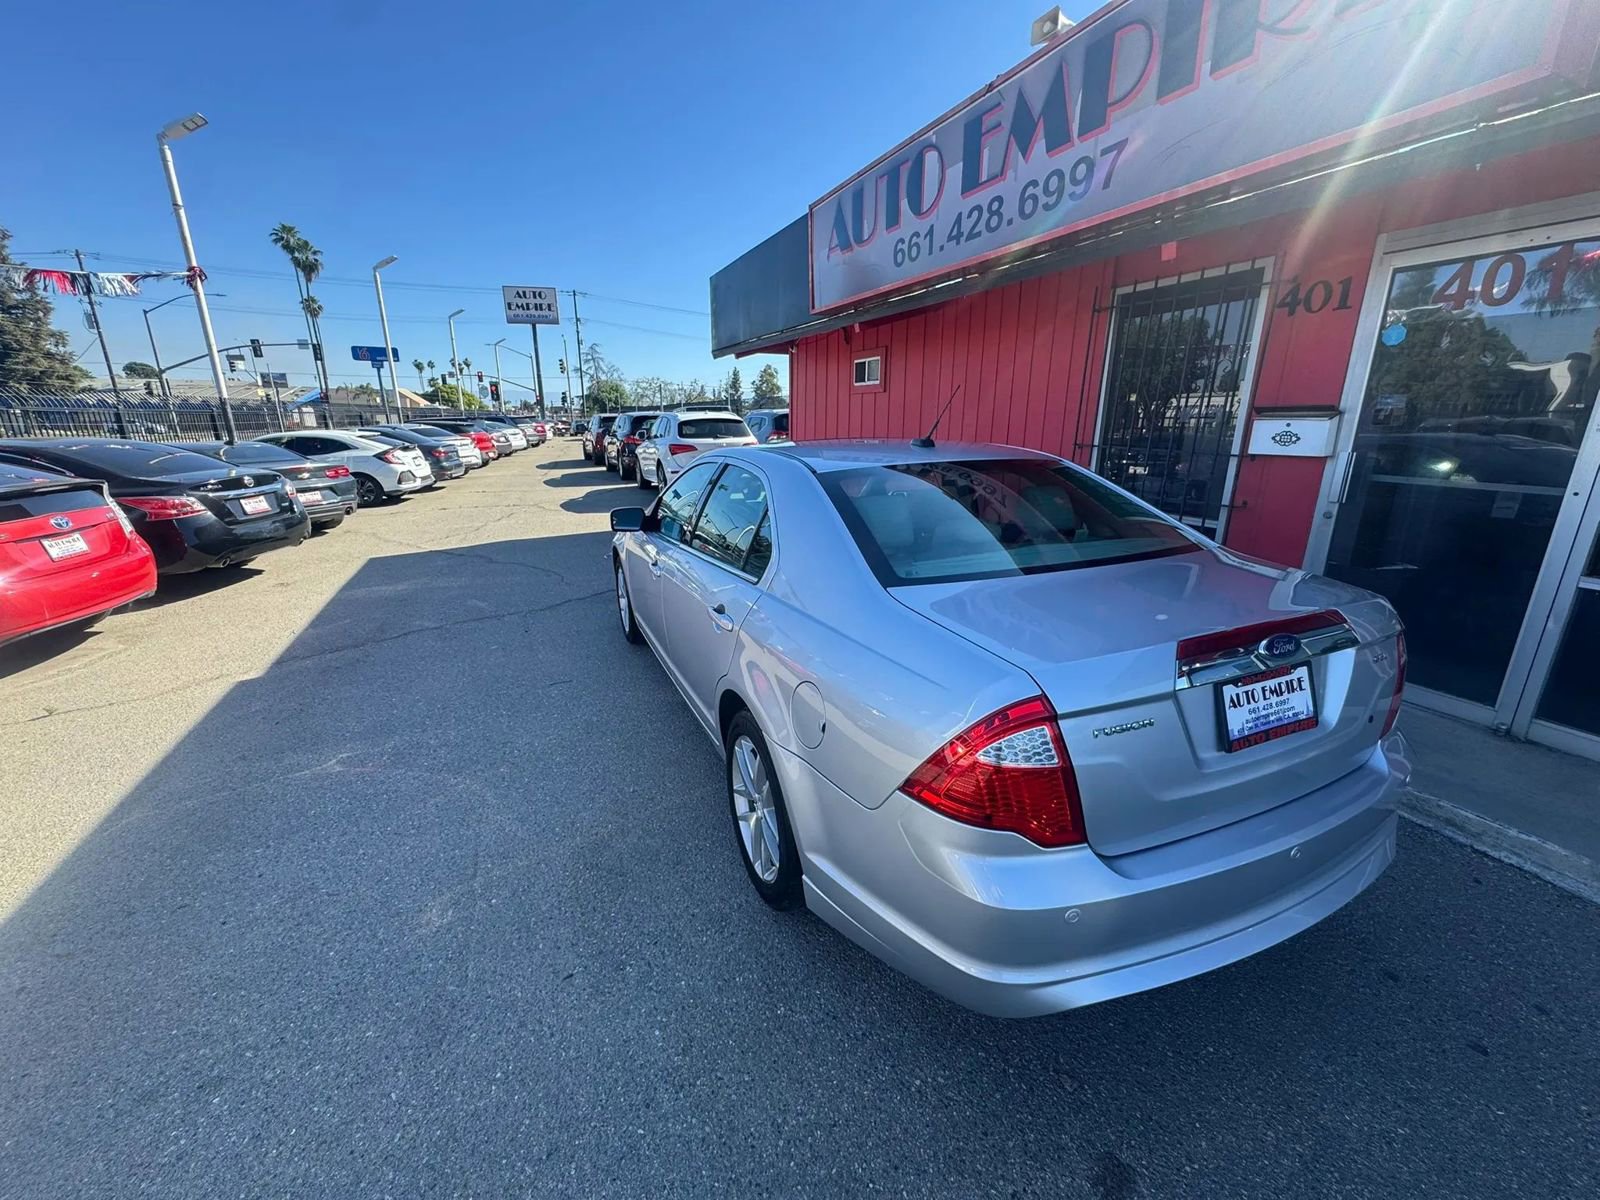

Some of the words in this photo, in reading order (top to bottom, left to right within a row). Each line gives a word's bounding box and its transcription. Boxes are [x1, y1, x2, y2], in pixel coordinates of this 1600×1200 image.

[827, 144, 946, 262] AUTO
[961, 0, 1386, 199] EMPIR
[893, 137, 1129, 268] 661.428.6997
[1431, 243, 1576, 311] 401
[513, 289, 547, 300] AUTO
[1275, 275, 1353, 318] 401
[507, 301, 555, 312] EMPIRE
[1273, 639, 1295, 655] Ford
[1228, 688, 1260, 710] AUTO
[1261, 676, 1306, 701] EMPIRE
[1248, 697, 1290, 716] 661.428.6997
[1092, 717, 1154, 739] FUSION
[1232, 732, 1265, 751] AUTO
